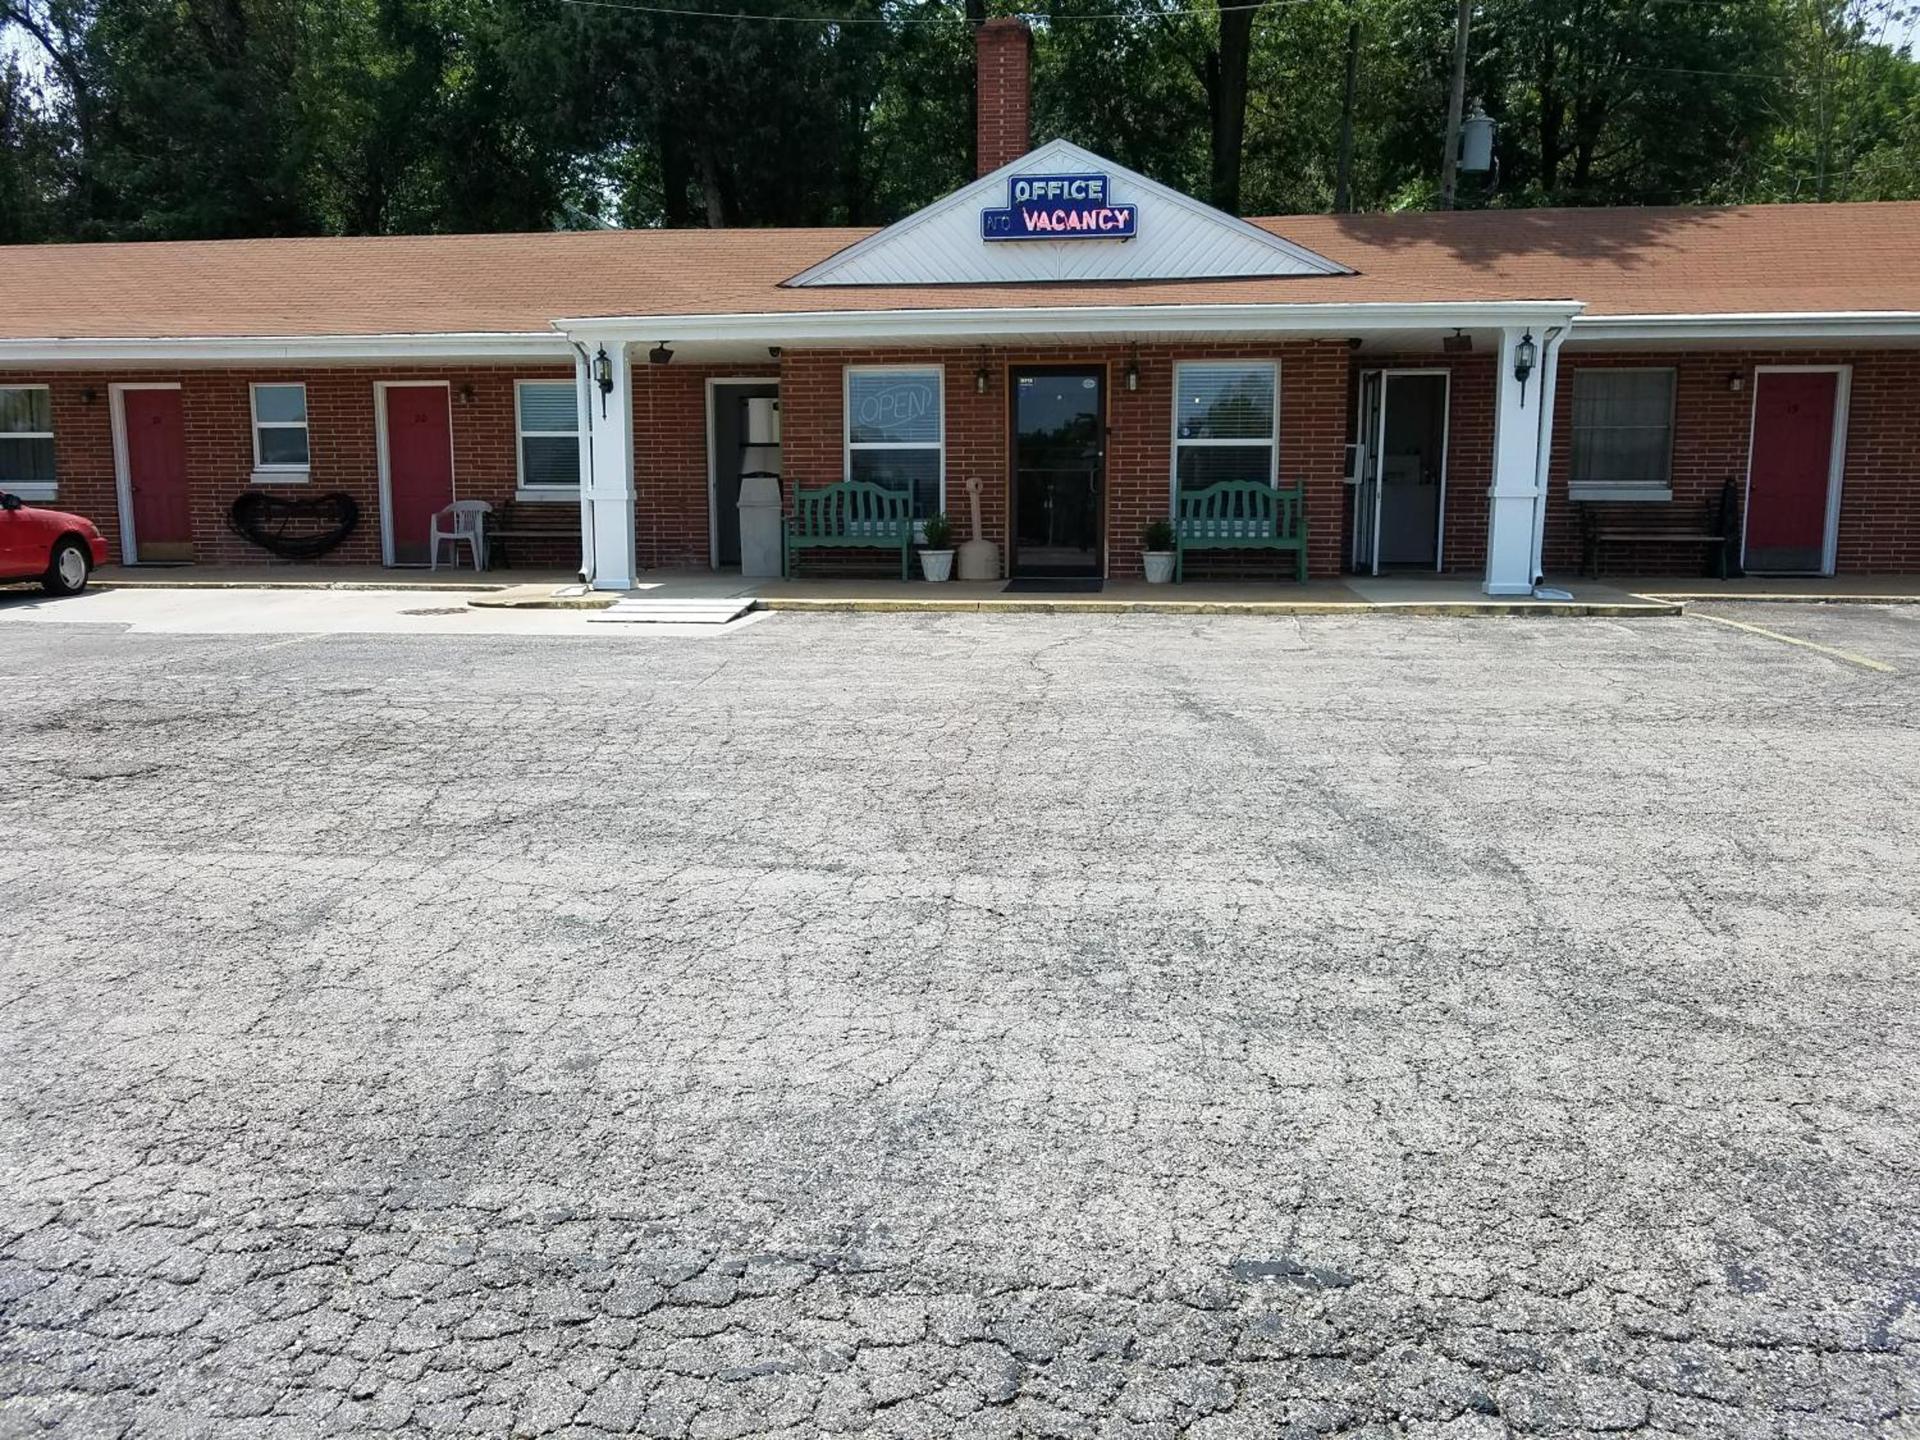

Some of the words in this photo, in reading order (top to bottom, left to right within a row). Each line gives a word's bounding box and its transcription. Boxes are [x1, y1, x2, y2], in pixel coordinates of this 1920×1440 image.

[1015, 180, 1103, 202] OFFICE
[1023, 207, 1130, 232] VACANCY
[861, 391, 926, 423] OPEN
